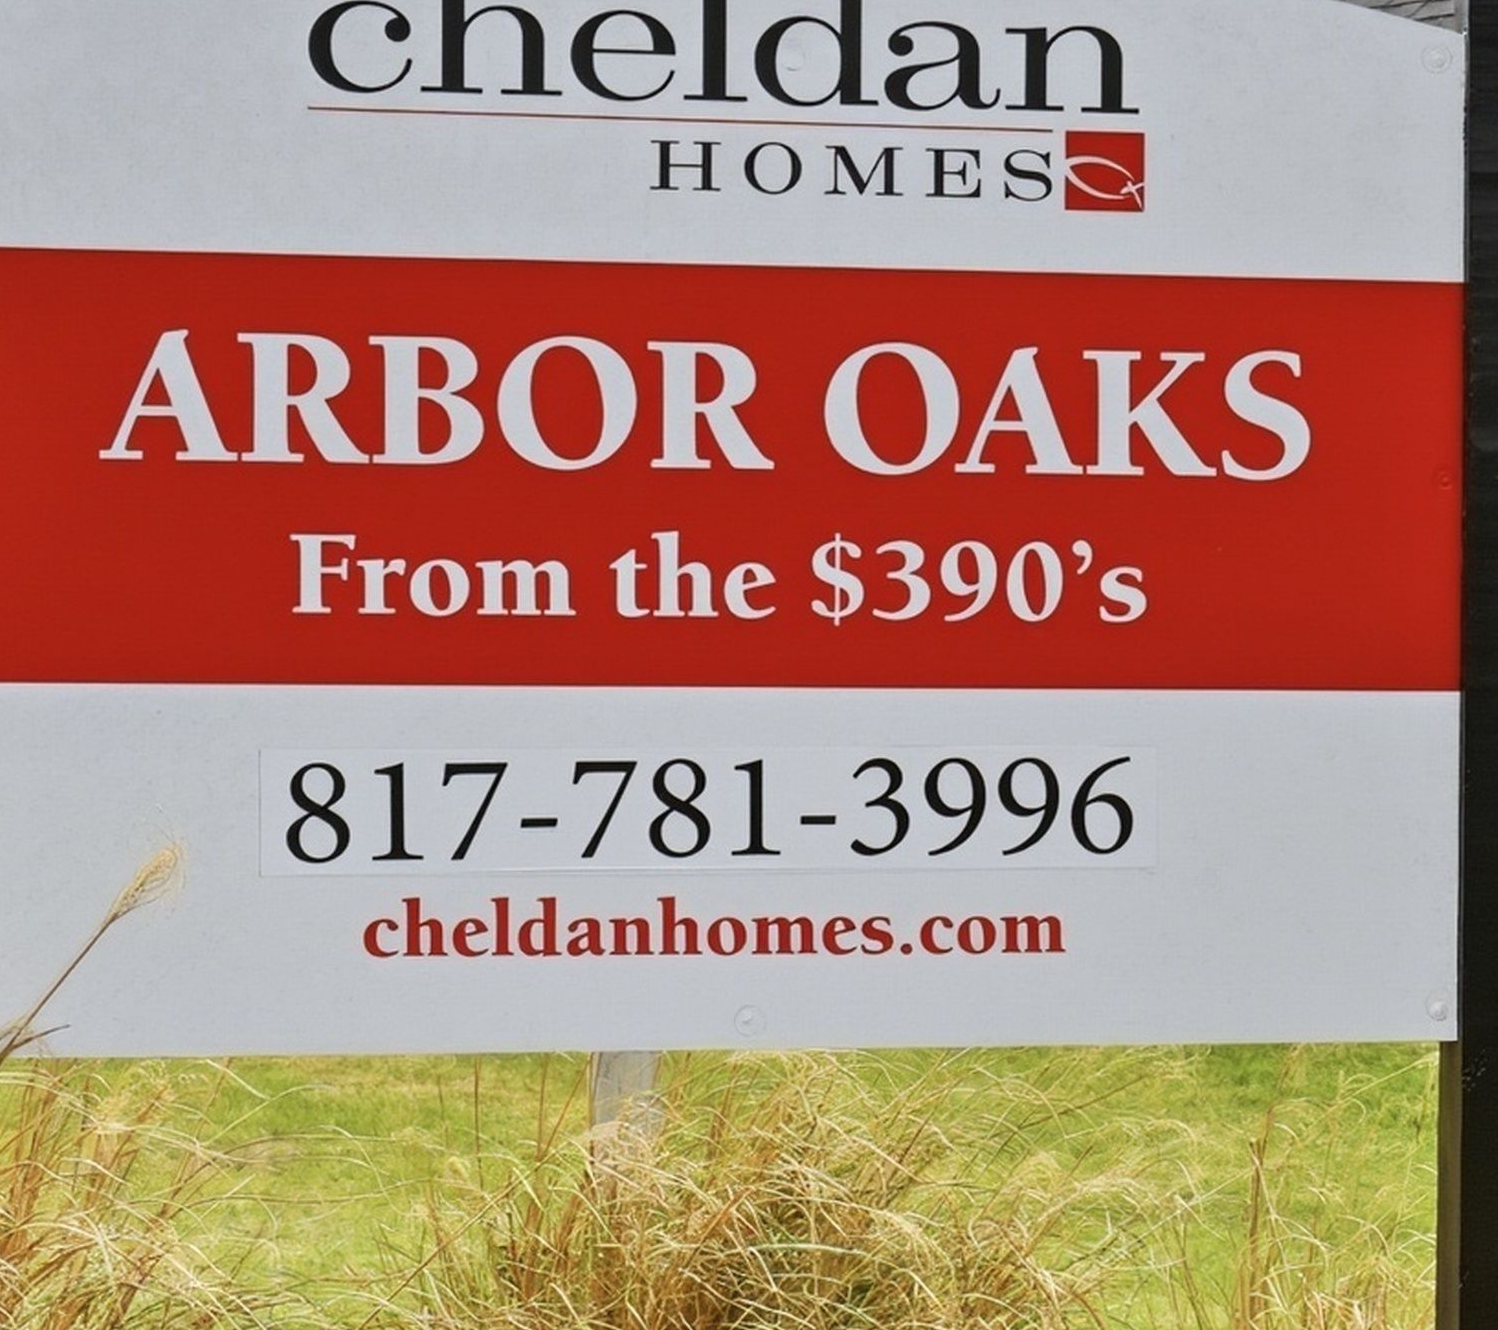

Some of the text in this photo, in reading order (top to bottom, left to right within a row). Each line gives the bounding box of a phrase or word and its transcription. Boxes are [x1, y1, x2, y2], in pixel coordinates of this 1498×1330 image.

[651, 139, 1053, 202] HOMES
[100, 330, 1311, 481] ARBOR OAKS
[290, 531, 1148, 626] From the $390’s
[286, 756, 1135, 864] 817-781-3996
[364, 897, 1065, 956] cheldanhomes.com
